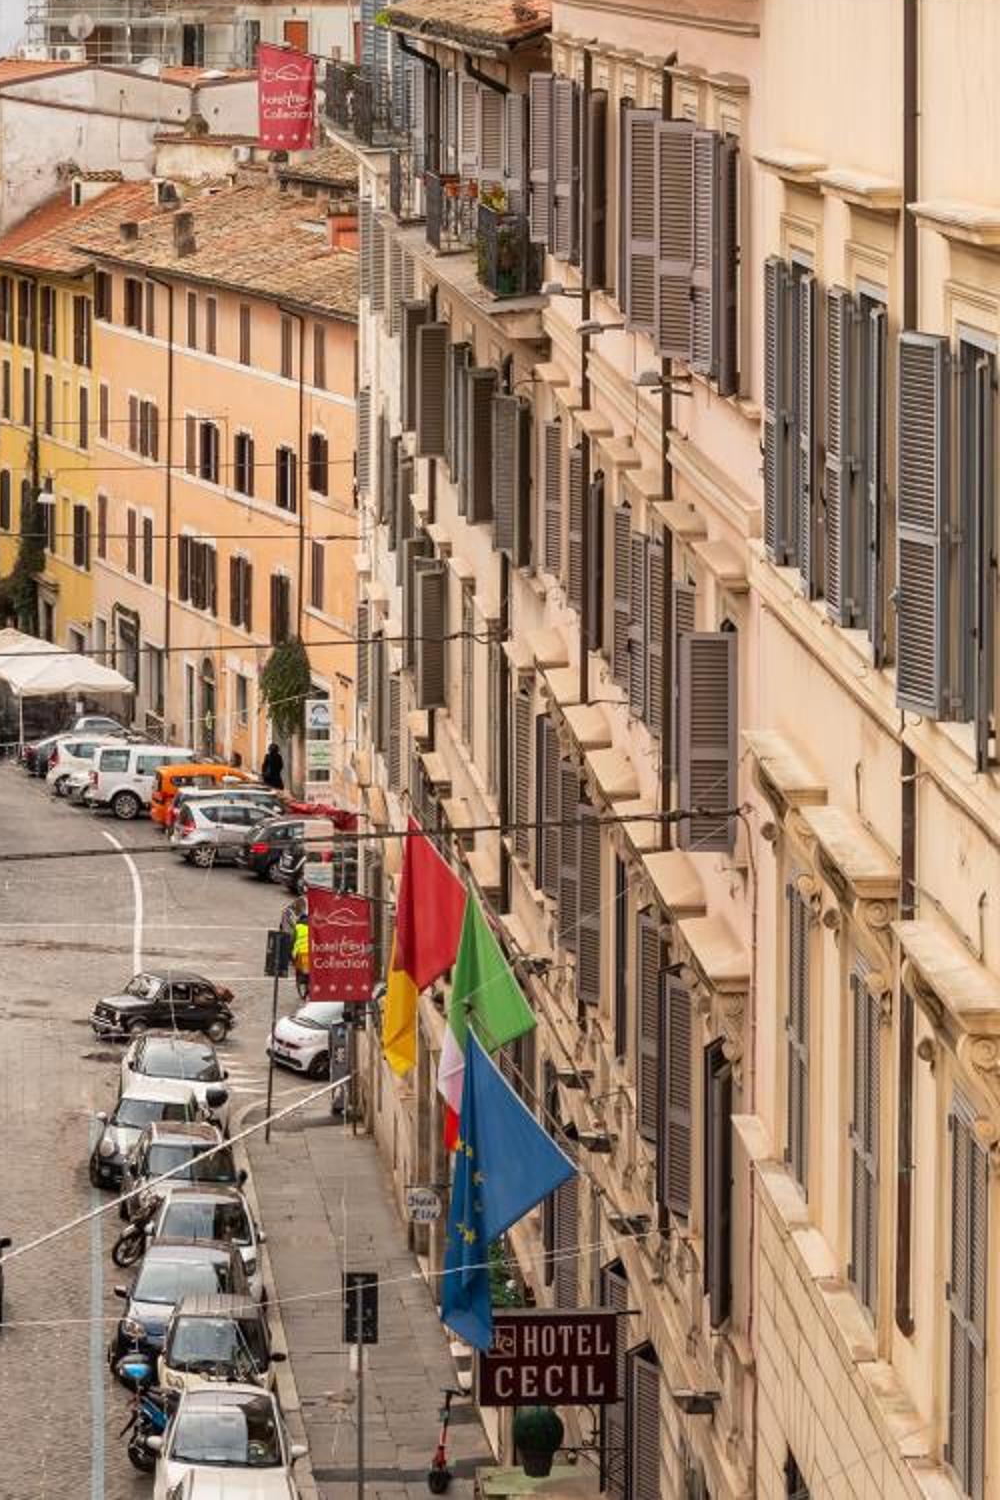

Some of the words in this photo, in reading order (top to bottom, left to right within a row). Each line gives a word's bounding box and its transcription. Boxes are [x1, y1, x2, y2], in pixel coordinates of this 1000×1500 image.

[313, 956, 369, 969] Collection
[523, 1324, 611, 1357] HOTEL
[494, 1365, 605, 1397] CECIL
